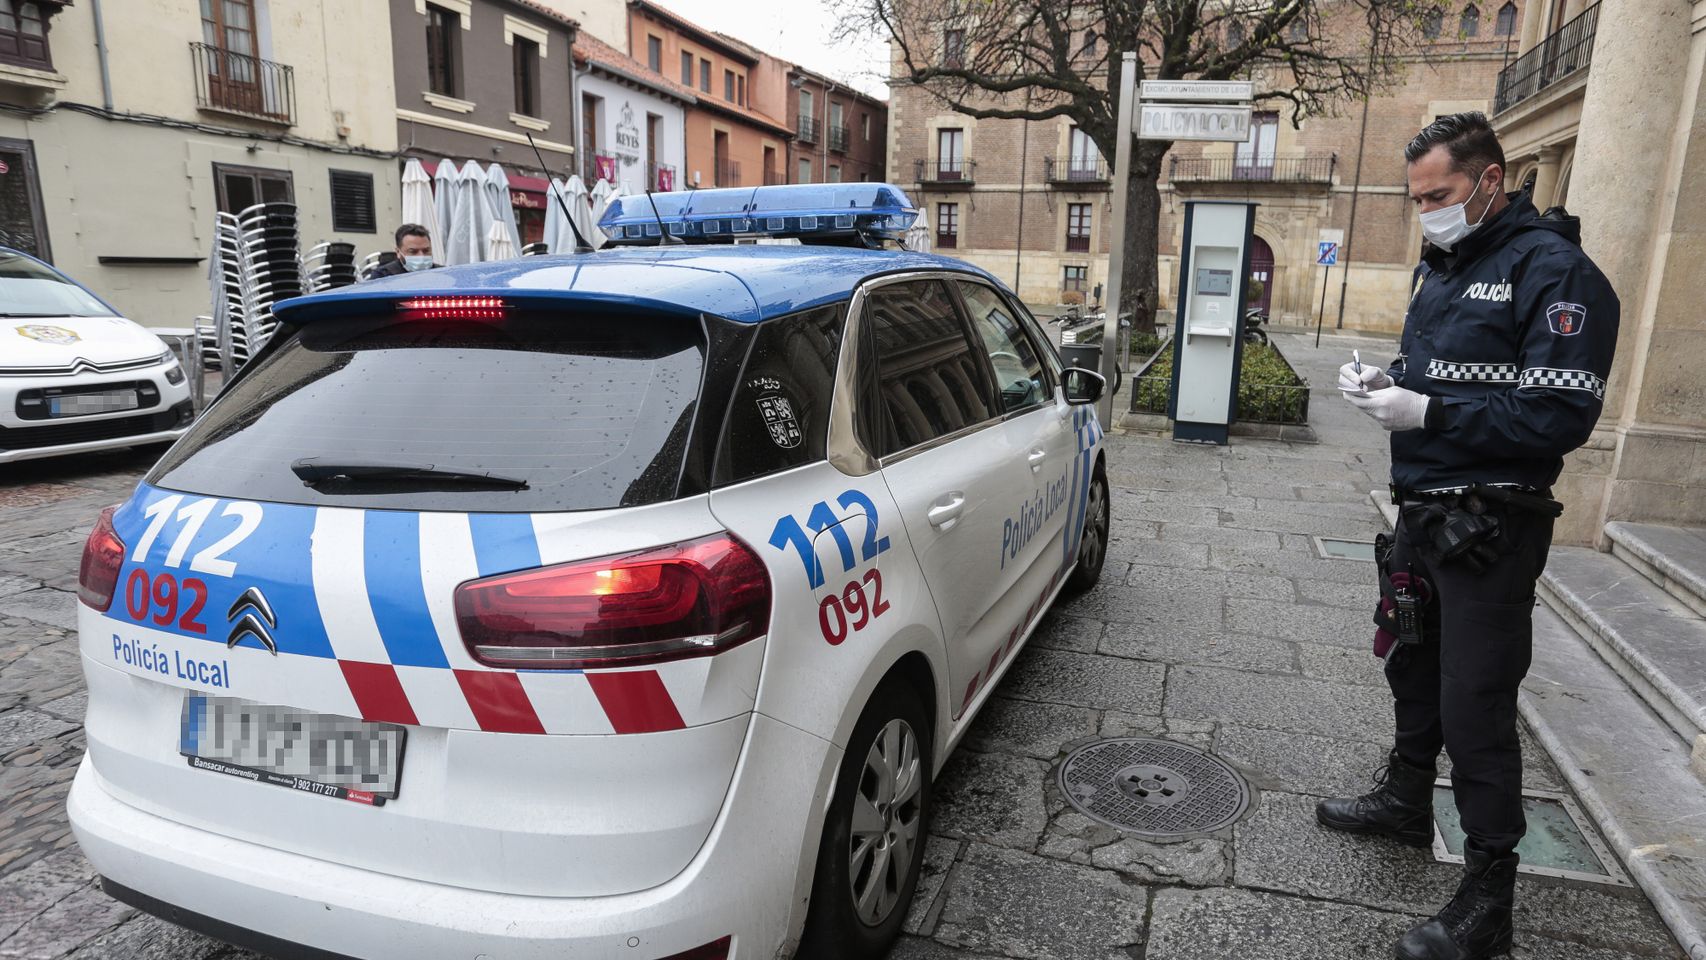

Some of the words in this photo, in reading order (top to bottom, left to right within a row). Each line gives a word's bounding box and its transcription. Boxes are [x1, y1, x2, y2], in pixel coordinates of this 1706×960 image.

[615, 131, 639, 148] REYES
[131, 494, 264, 578] 112
[768, 489, 891, 591] 112
[1000, 489, 1043, 570] Policía
[1045, 463, 1068, 522] Local
[125, 568, 208, 634] 092
[818, 568, 891, 646] 092
[112, 633, 169, 675] Policía
[175, 650, 230, 689] Local
[194, 756, 225, 773] Bansacar
[224, 766, 259, 781] autorenting
[297, 779, 310, 791] 902
[311, 782, 324, 794] 177
[324, 785, 338, 797] 277
